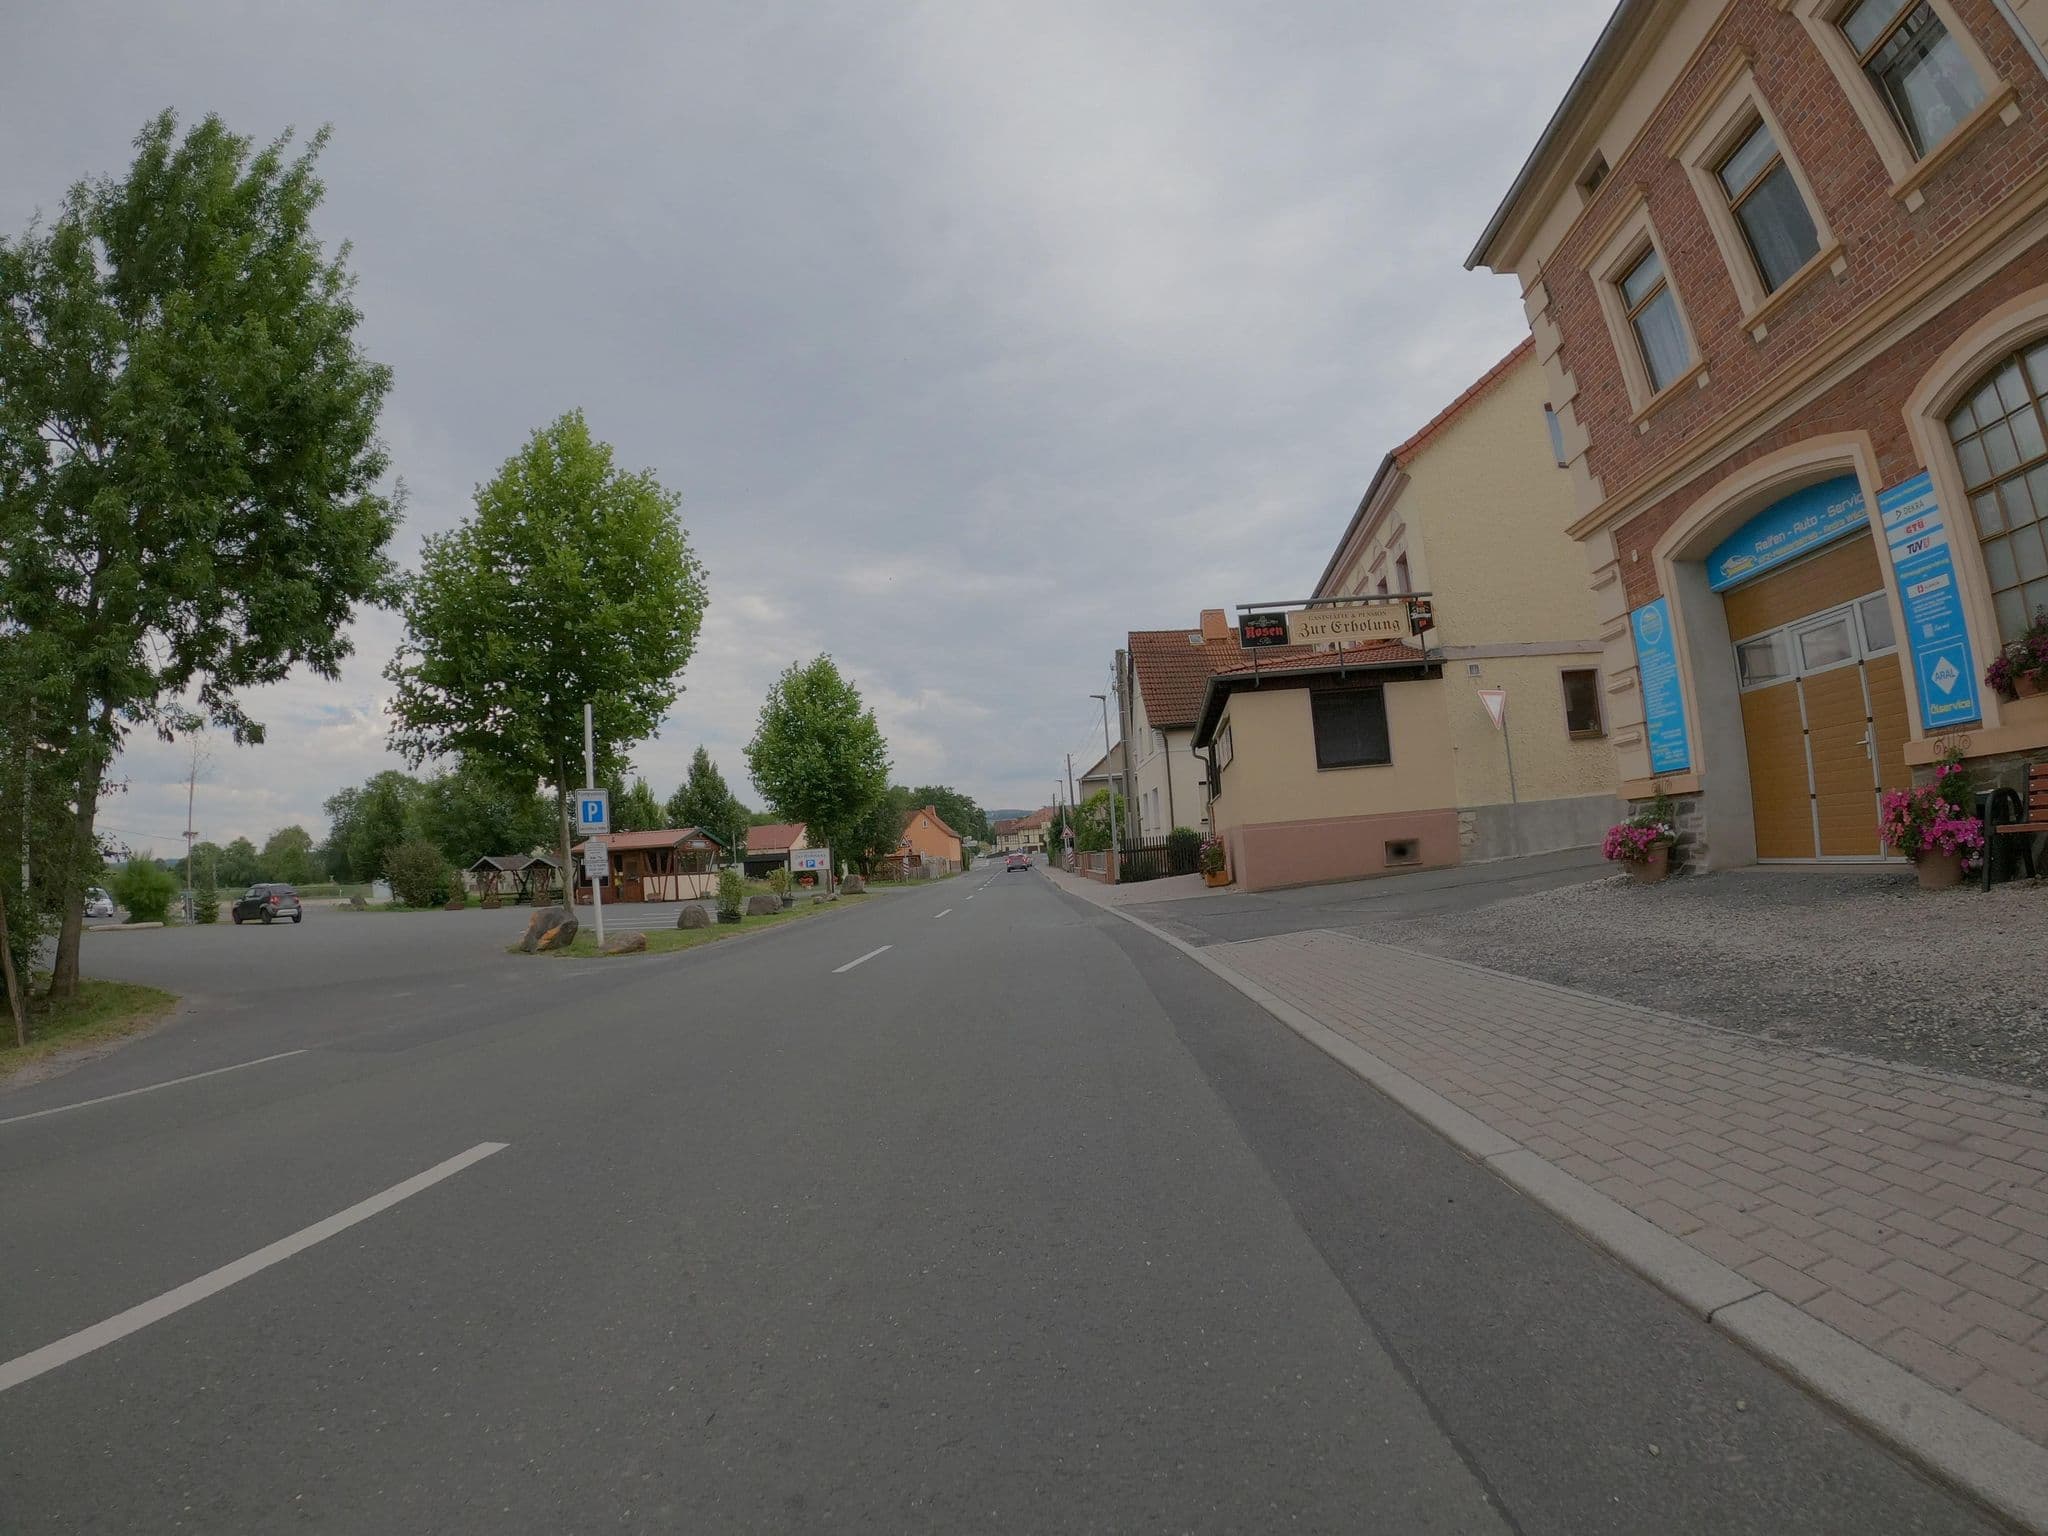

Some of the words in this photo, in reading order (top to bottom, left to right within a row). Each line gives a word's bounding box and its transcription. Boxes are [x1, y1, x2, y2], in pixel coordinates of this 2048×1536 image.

[1754, 531, 1786, 553] Reifen
[1793, 515, 1818, 534] Auto
[1827, 492, 1865, 517] Servic
[1299, 623, 1327, 638] Zur
[1331, 619, 1400, 634] Erholung
[1935, 668, 1956, 682] ARAL
[588, 802, 598, 822] P
